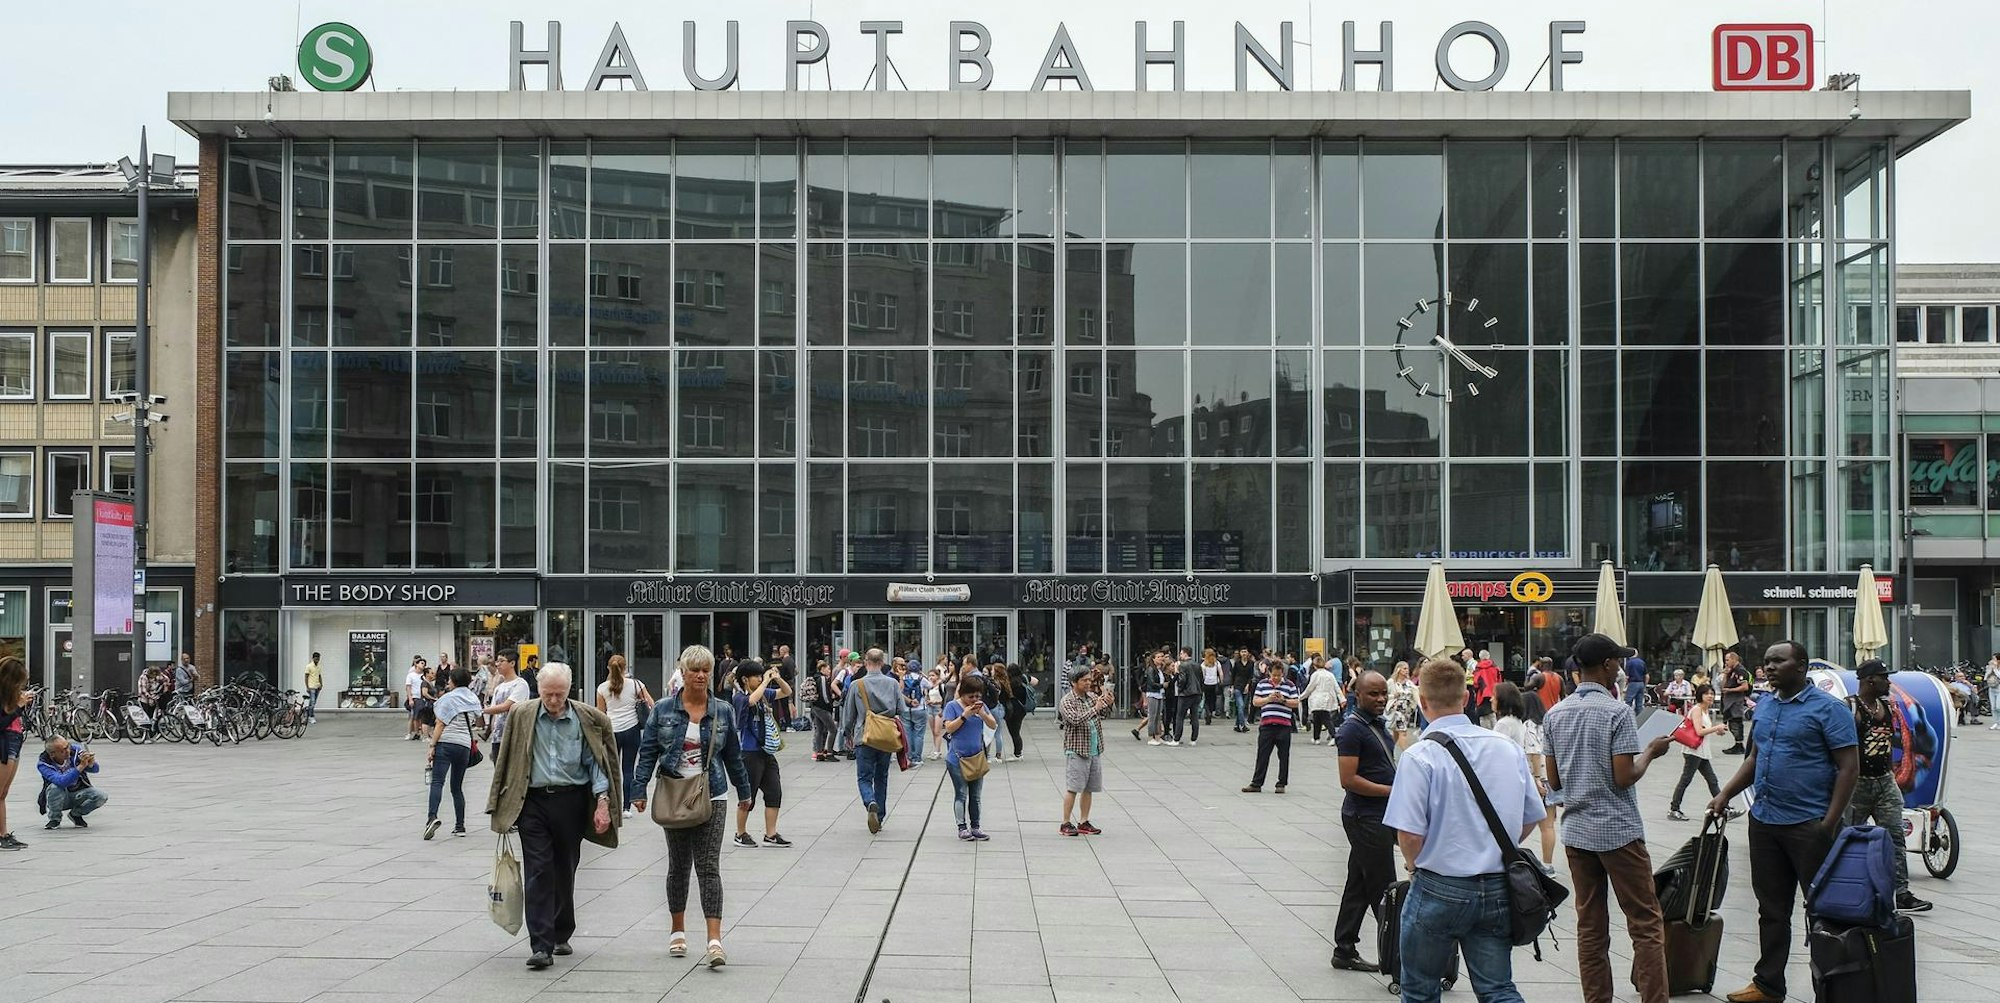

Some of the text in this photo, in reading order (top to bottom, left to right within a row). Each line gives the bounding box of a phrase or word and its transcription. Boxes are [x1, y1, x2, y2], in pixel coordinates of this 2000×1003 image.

[312, 29, 356, 84] S
[509, 20, 1586, 92] HAUPTBAHNHOF
[1726, 35, 1802, 81] DB
[292, 584, 456, 601] THE BODY SHOP
[627, 580, 692, 604] Kölner
[1022, 579, 1088, 604] Kölner
[1447, 581, 1508, 602] amps
[1763, 585, 1806, 599] schnell.
